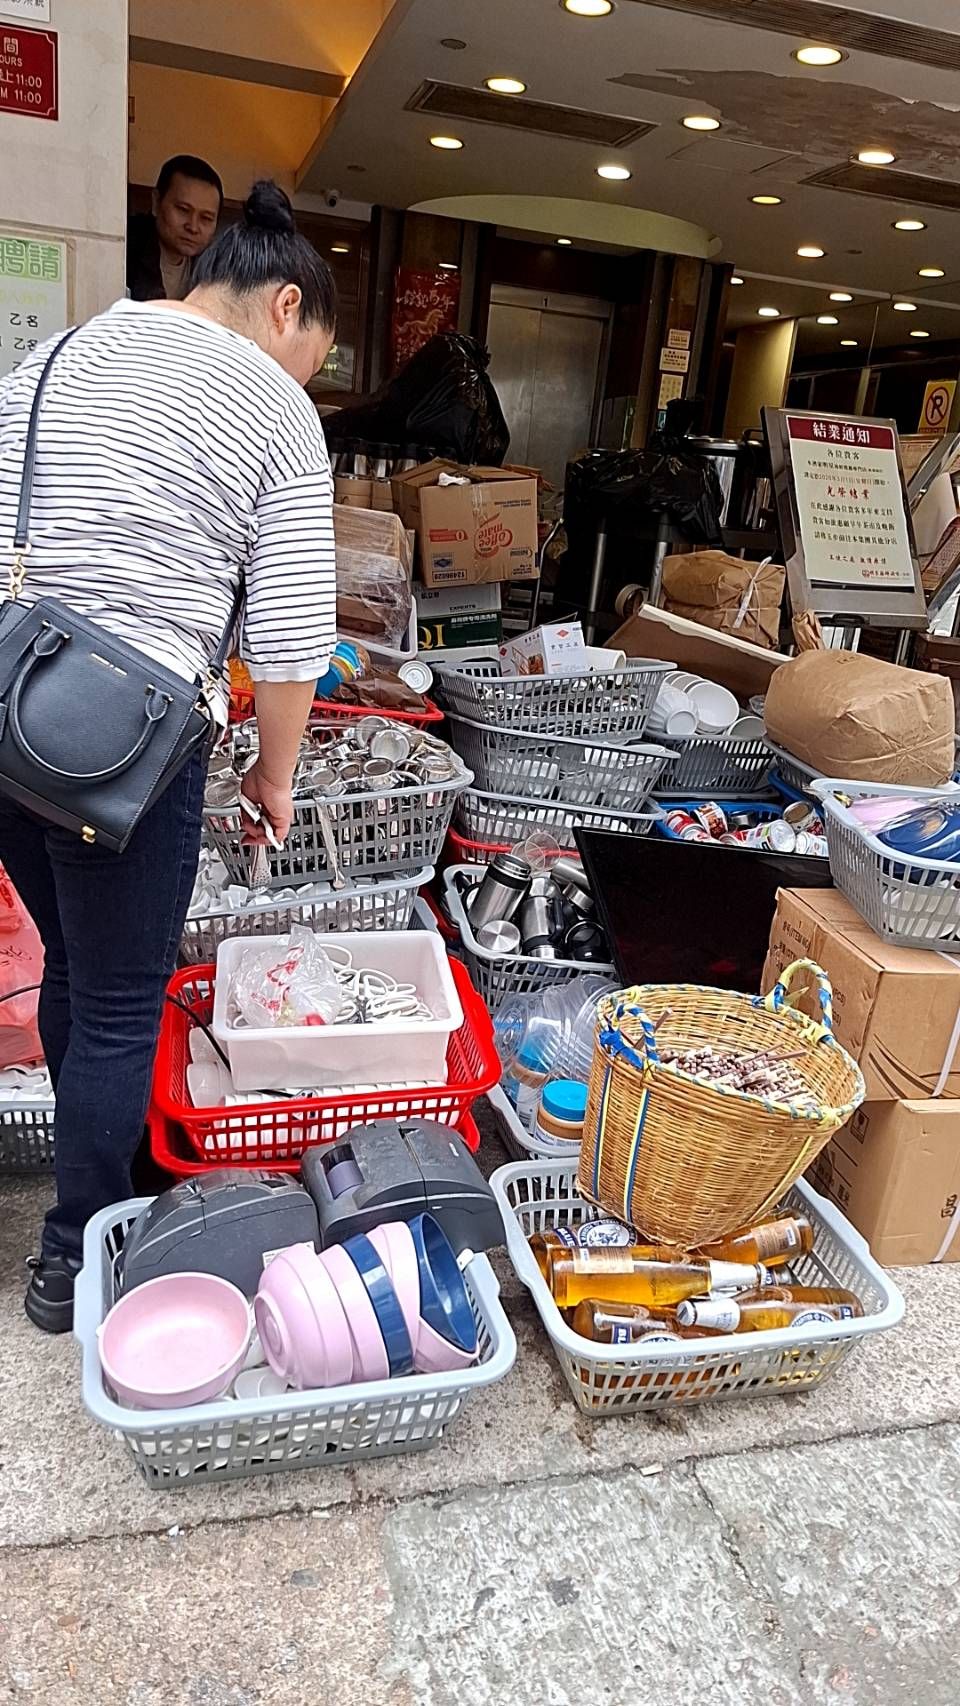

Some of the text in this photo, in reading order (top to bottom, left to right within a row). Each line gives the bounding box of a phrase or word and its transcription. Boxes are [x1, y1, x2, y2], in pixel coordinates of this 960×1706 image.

[3, 36, 19, 56] 間
[14, 89, 42, 105] 11:00
[812, 421, 870, 444] 結業通知
